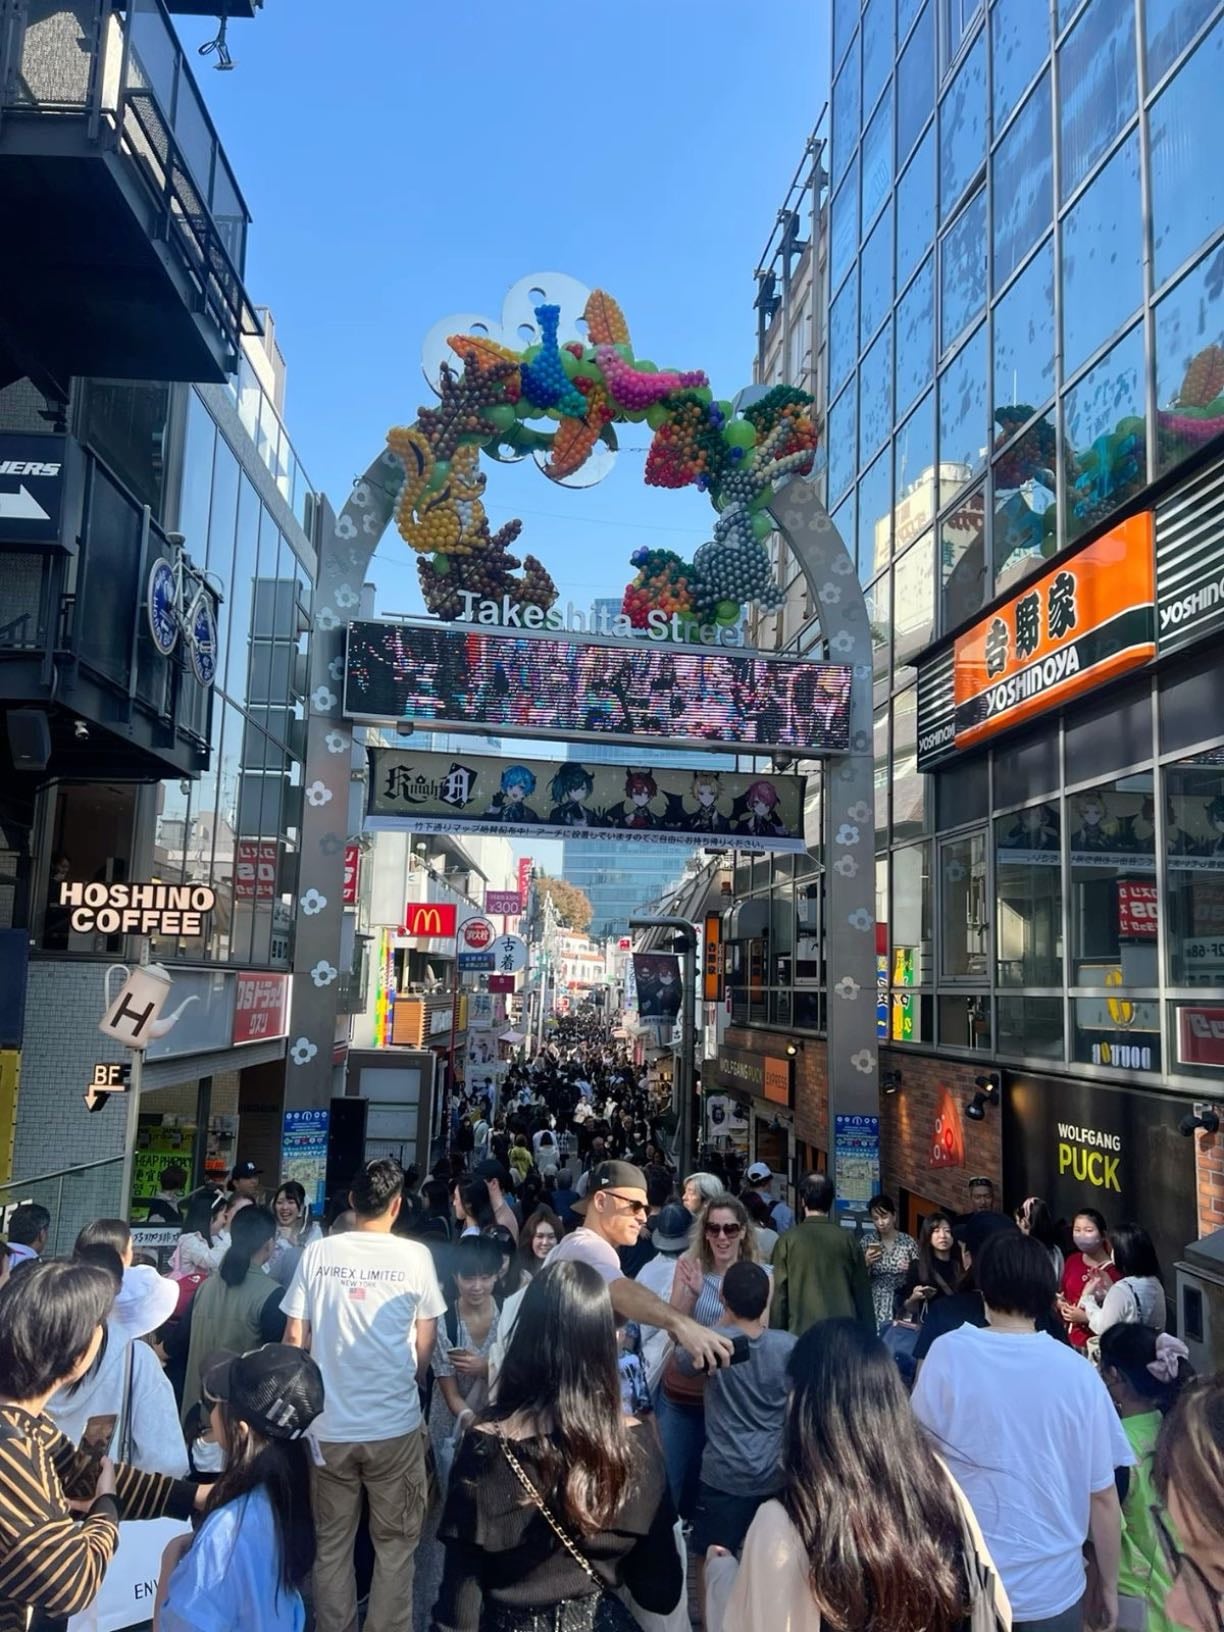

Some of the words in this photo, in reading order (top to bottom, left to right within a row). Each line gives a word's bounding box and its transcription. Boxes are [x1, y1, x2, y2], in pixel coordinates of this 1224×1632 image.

[457, 588, 634, 640] Takeshita
[646, 608, 753, 650] Street
[986, 645, 1081, 716] YOSHINOYA
[60, 882, 214, 911] HOSHINO
[71, 907, 201, 935] COFFEE
[500, 937, 517, 971] 古着
[110, 992, 155, 1038] H
[94, 1065, 121, 1085] BF
[1058, 1122, 1121, 1151] WOLFGANG
[1059, 1143, 1122, 1193] PUCK
[315, 1265, 357, 1280] AVIREX
[360, 1269, 407, 1283] LIMITED
